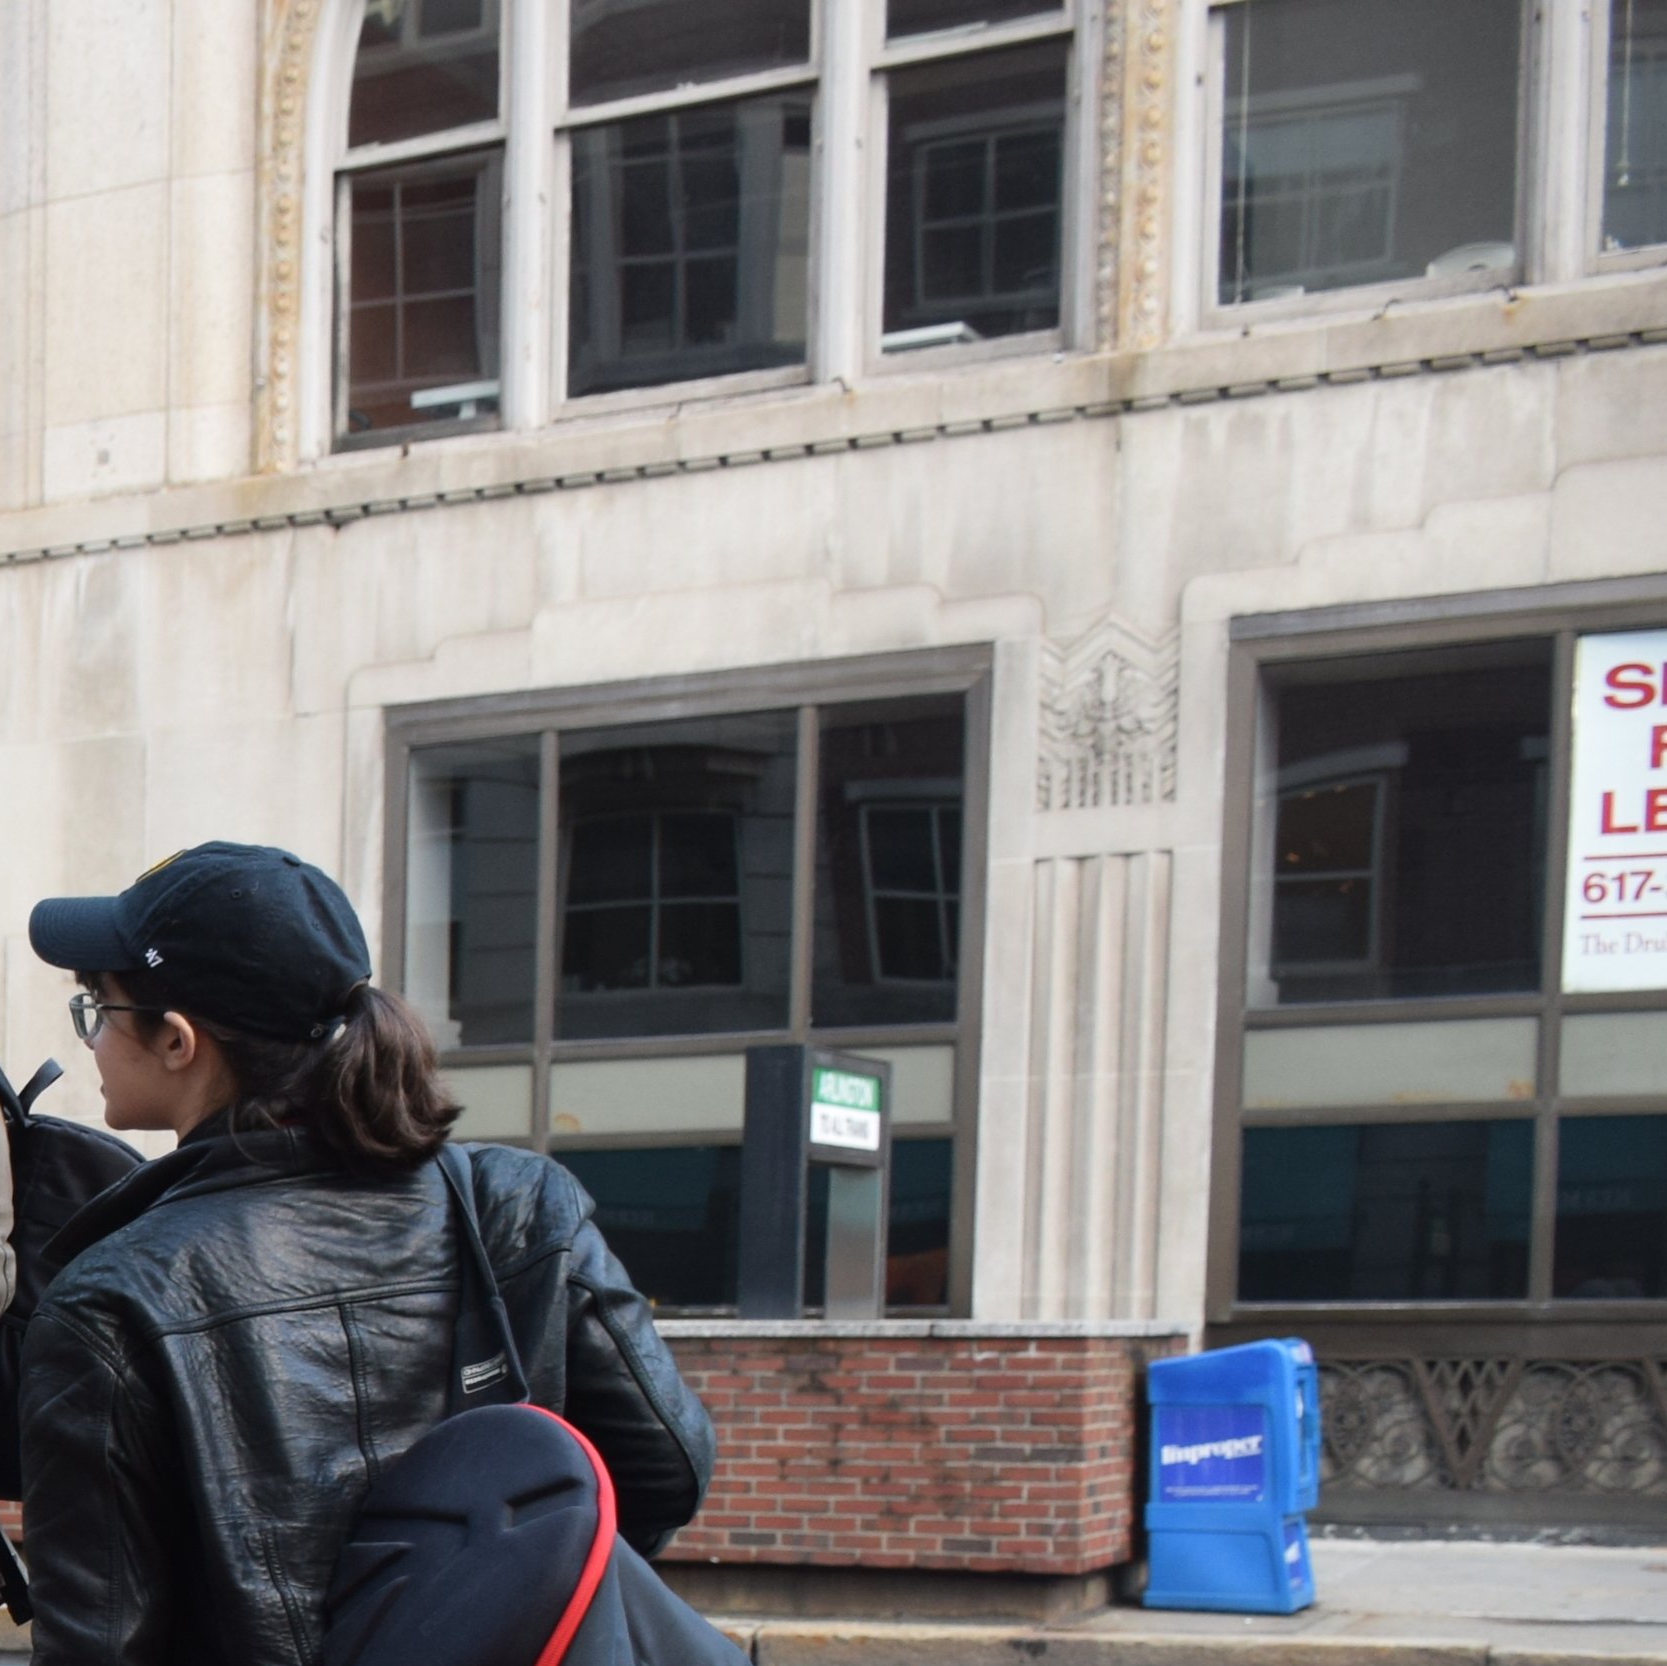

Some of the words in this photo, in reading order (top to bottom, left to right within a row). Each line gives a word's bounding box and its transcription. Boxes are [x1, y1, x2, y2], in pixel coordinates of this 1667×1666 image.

[1603, 663, 1667, 711] S
[1583, 871, 1667, 903] 617-
[1581, 933, 1619, 954] The
[1625, 930, 1667, 953] Dru
